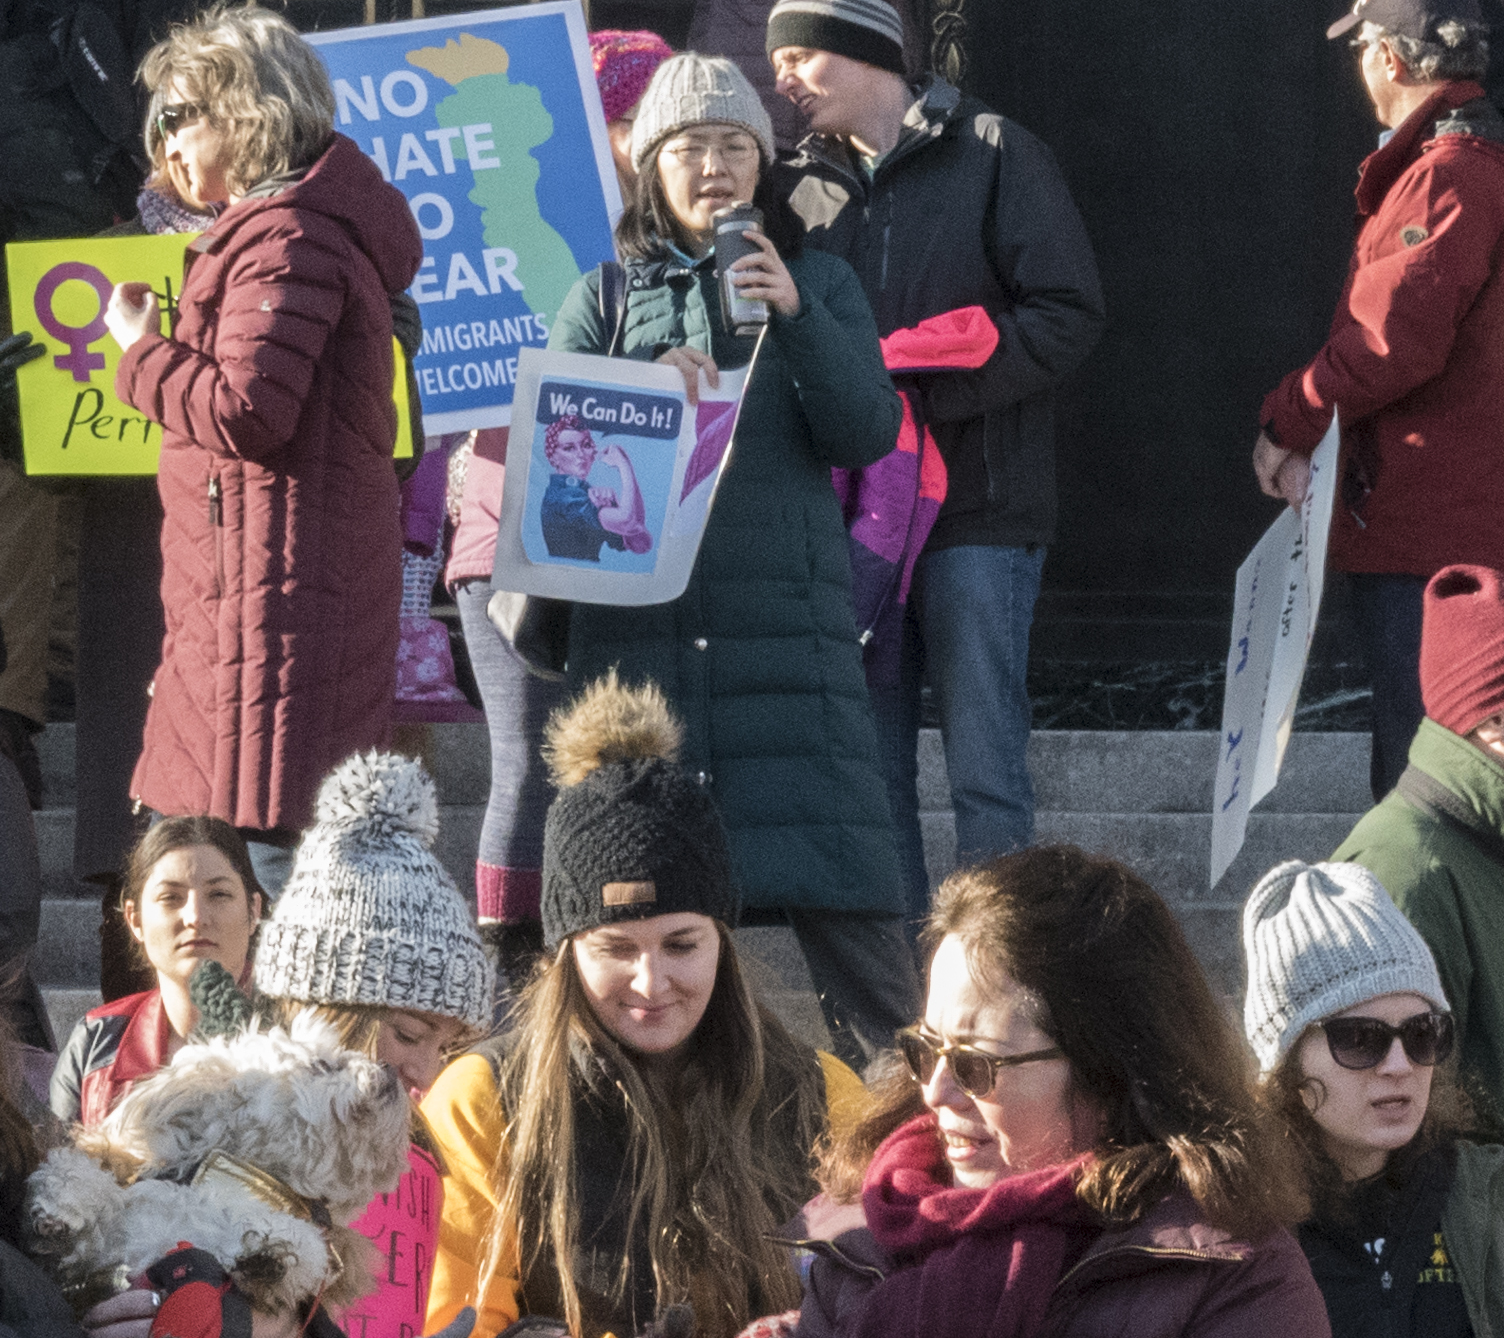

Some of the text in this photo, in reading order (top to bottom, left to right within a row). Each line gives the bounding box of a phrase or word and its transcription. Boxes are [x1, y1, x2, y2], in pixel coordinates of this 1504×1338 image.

[337, 69, 429, 126] NO
[407, 192, 455, 240] O
[408, 247, 526, 305] EAR
[415, 312, 551, 358] MIGRANTS
[550, 392, 580, 418] We
[582, 397, 617, 423] Can
[619, 401, 647, 427] Do
